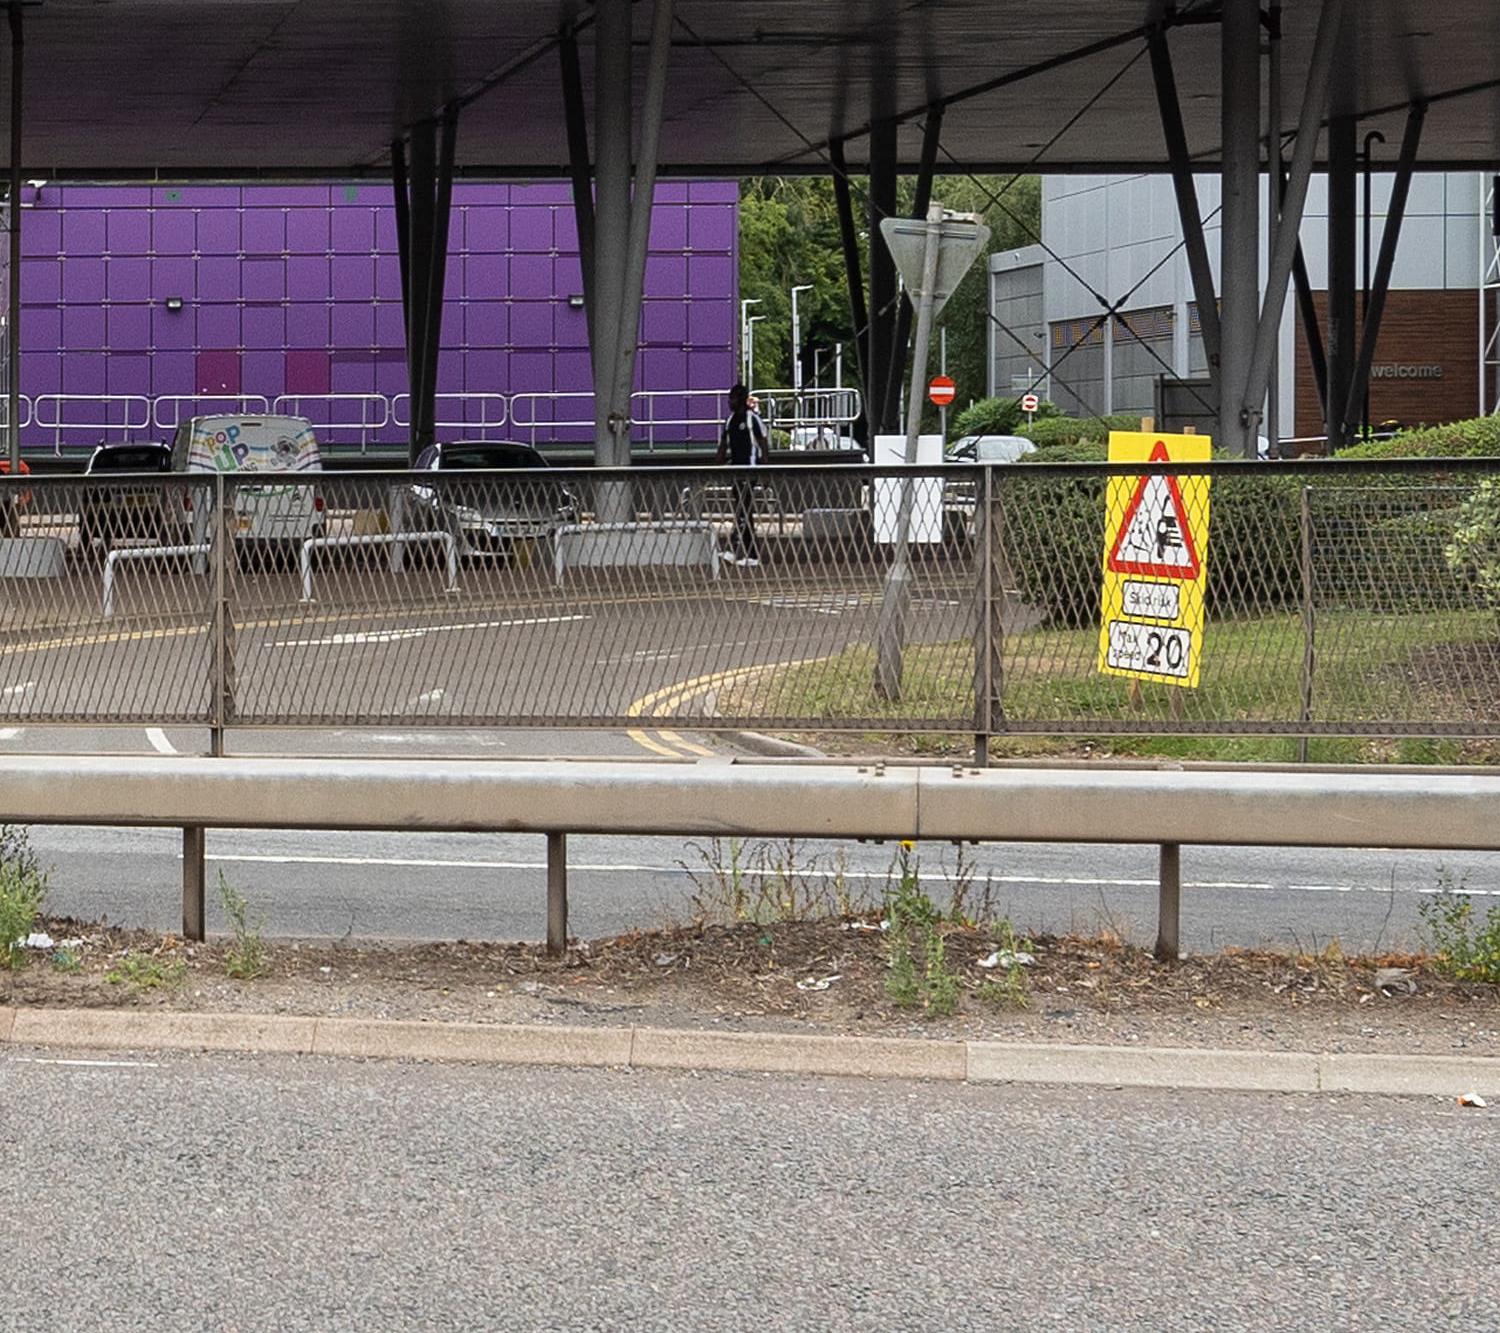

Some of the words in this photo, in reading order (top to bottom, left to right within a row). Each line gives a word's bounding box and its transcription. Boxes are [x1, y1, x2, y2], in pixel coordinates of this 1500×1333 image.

[1371, 363, 1443, 378] welcome
[205, 425, 241, 455] POP
[1147, 632, 1182, 669] 20
